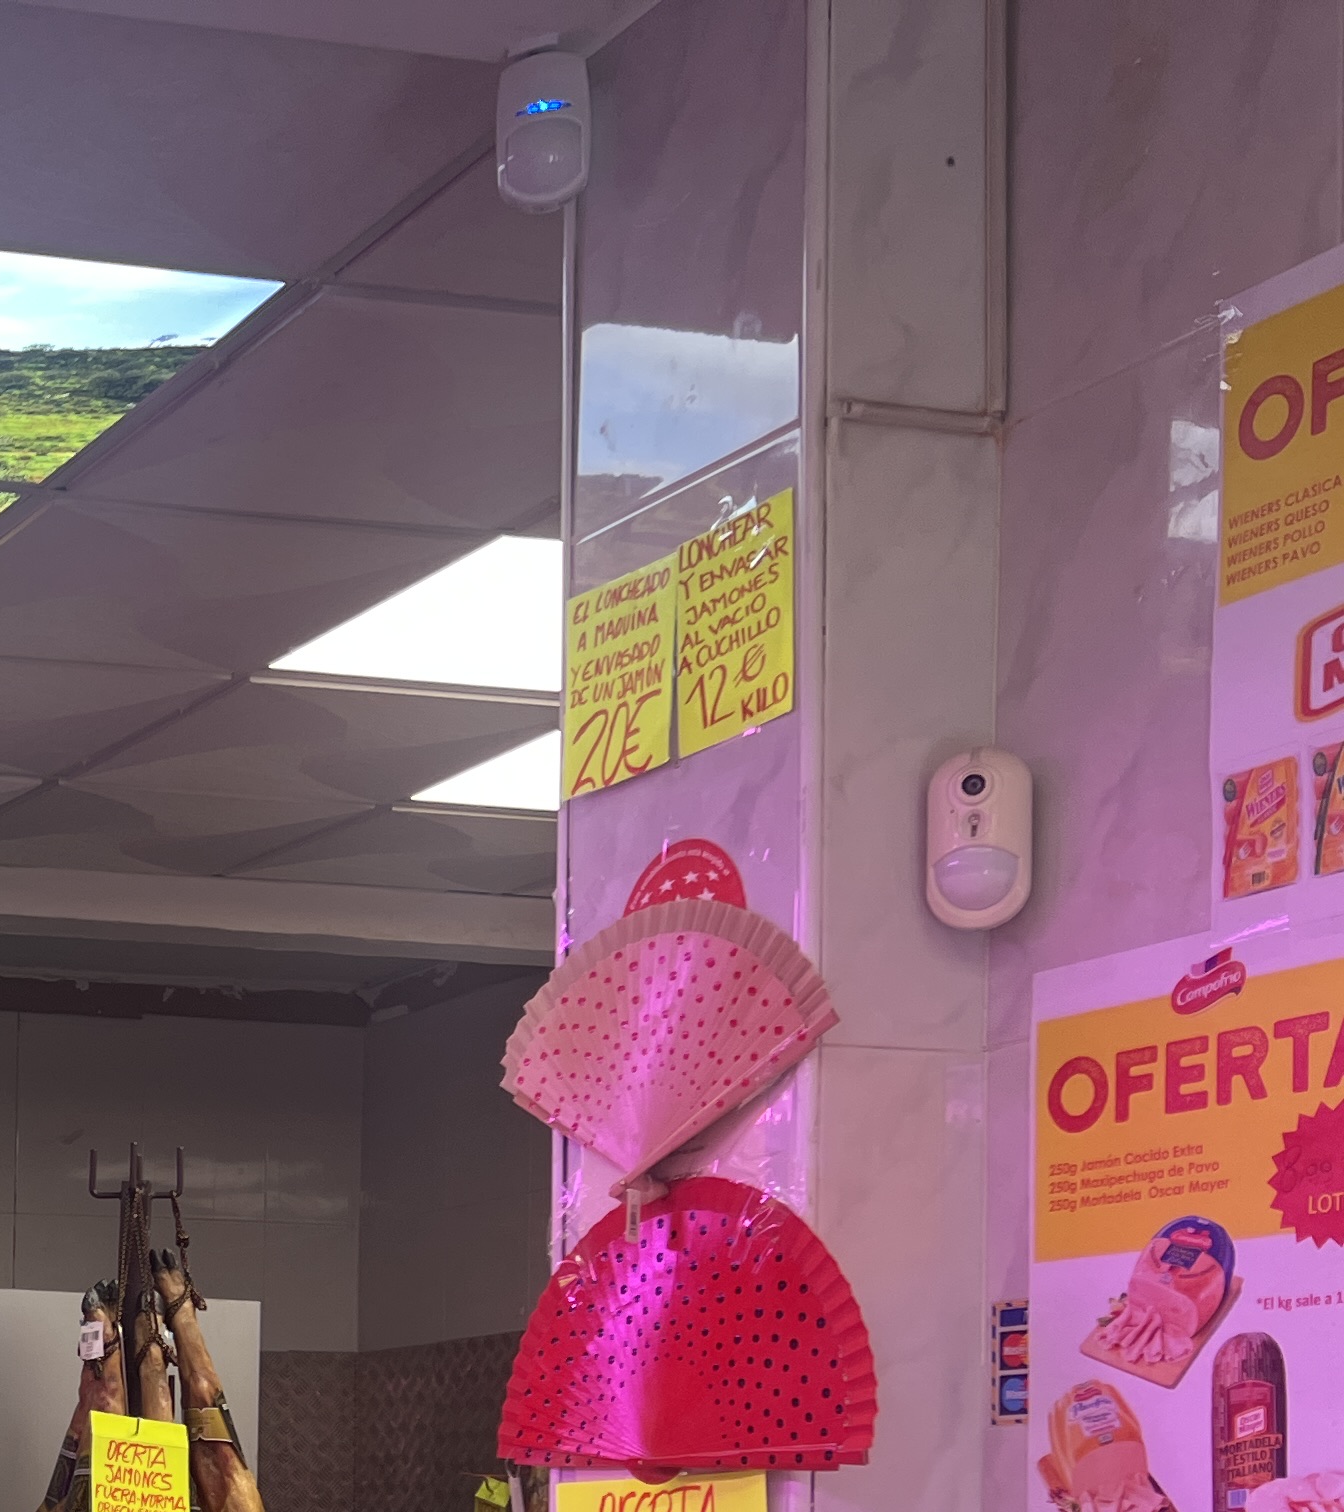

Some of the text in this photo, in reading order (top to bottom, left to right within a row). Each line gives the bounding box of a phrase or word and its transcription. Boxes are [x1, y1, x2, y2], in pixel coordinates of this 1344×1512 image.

[1227, 500, 1330, 549] WIENERS QUESO
[1228, 474, 1343, 530] WIENERS CLASICA
[679, 502, 775, 574] LONCHEAR
[1226, 520, 1327, 569] WIENERS POLLO
[679, 536, 789, 600] Y ENVASAR
[1226, 540, 1321, 587] WIENERS PAVO
[573, 567, 671, 625] EL LONCHEADO
[685, 562, 779, 625] JAMONES
[577, 633, 587, 652] A
[677, 607, 781, 677] A CUCHILLO
[680, 593, 766, 654] AL VACIO
[582, 634, 660, 680] ENVASADO
[570, 685, 589, 709] DE
[593, 680, 613, 702] UN
[685, 663, 735, 729] 12
[741, 671, 789, 722] KILO
[1049, 1144, 1203, 1177] 250g Jamón Cocido Extra
[1049, 1159, 1219, 1194] 250g Maxipechuga de Pavo
[1049, 1199, 1078, 1213] 250g
[1149, 1184, 1185, 1199] Oscar
[1188, 1178, 1229, 1195] Mayer
[1296, 1294, 1322, 1308] sale
[104, 1464, 172, 1491] JAMONES
[107, 1440, 166, 1469] OFERTA
